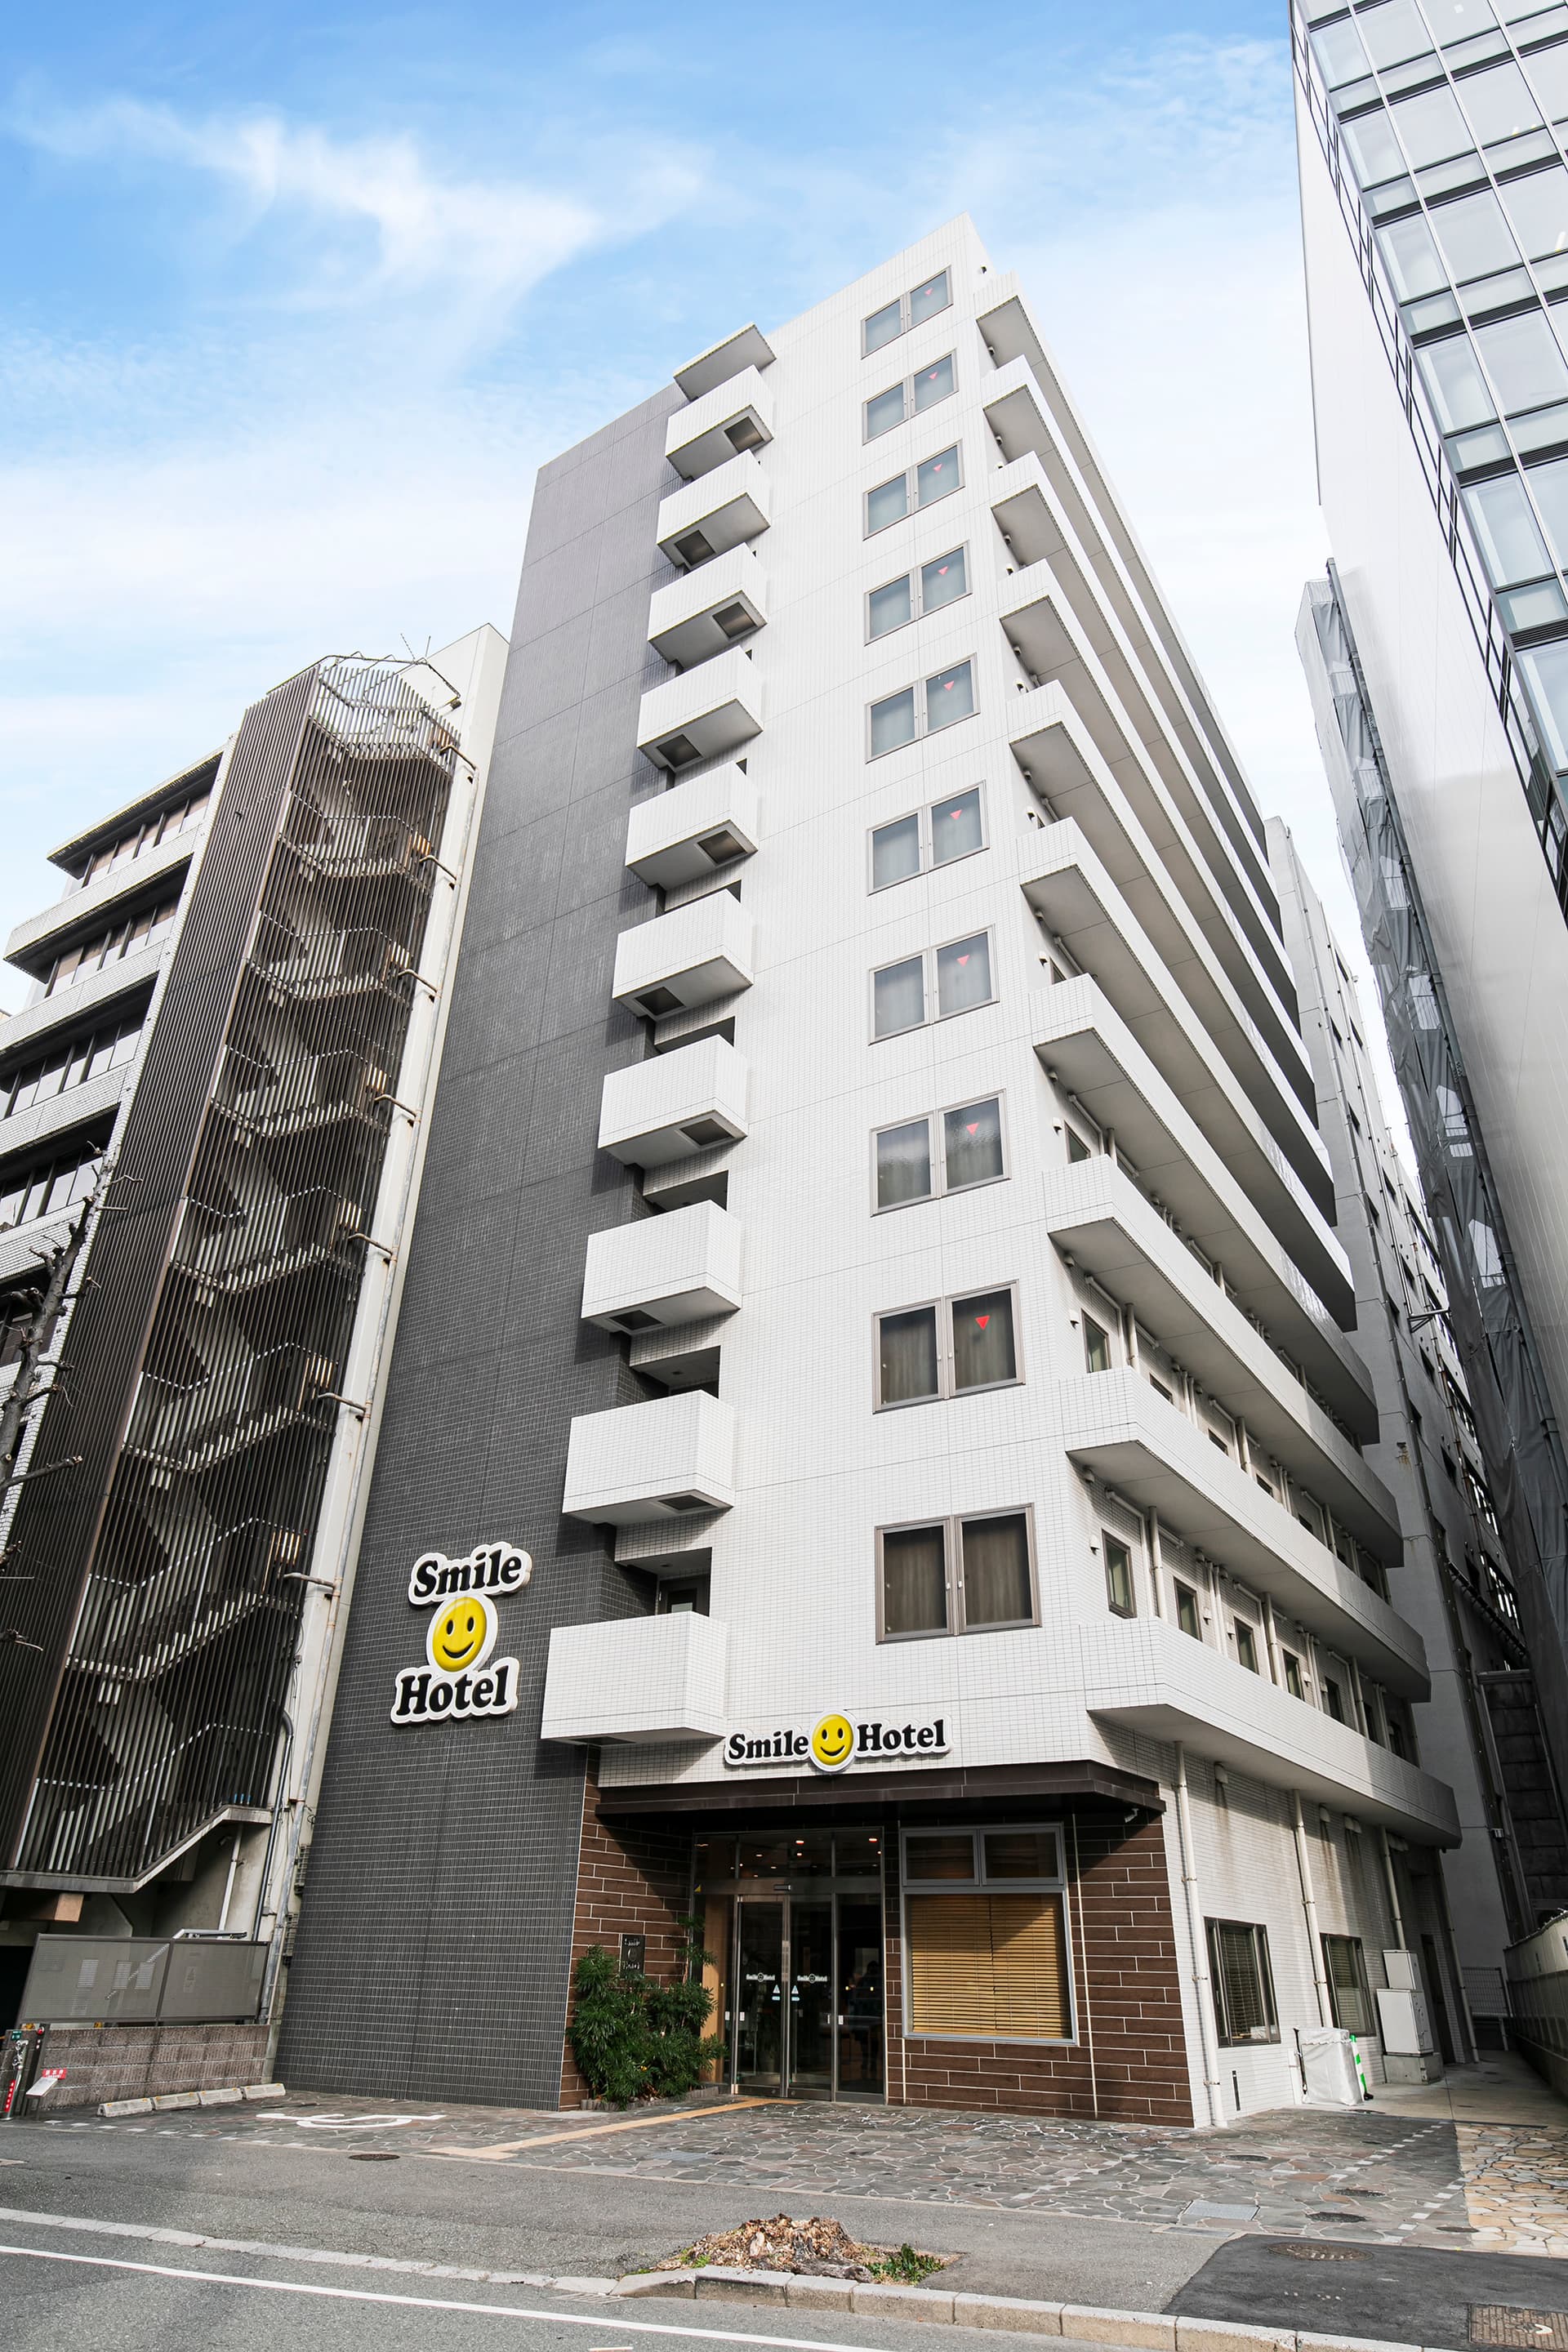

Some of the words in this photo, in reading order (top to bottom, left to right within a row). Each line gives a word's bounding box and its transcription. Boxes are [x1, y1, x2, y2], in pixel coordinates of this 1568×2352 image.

[414, 1549, 521, 1597] Smile
[396, 1665, 508, 1715] Hotel
[728, 1730, 808, 1758] Smile
[858, 1719, 946, 1751] Hotel
